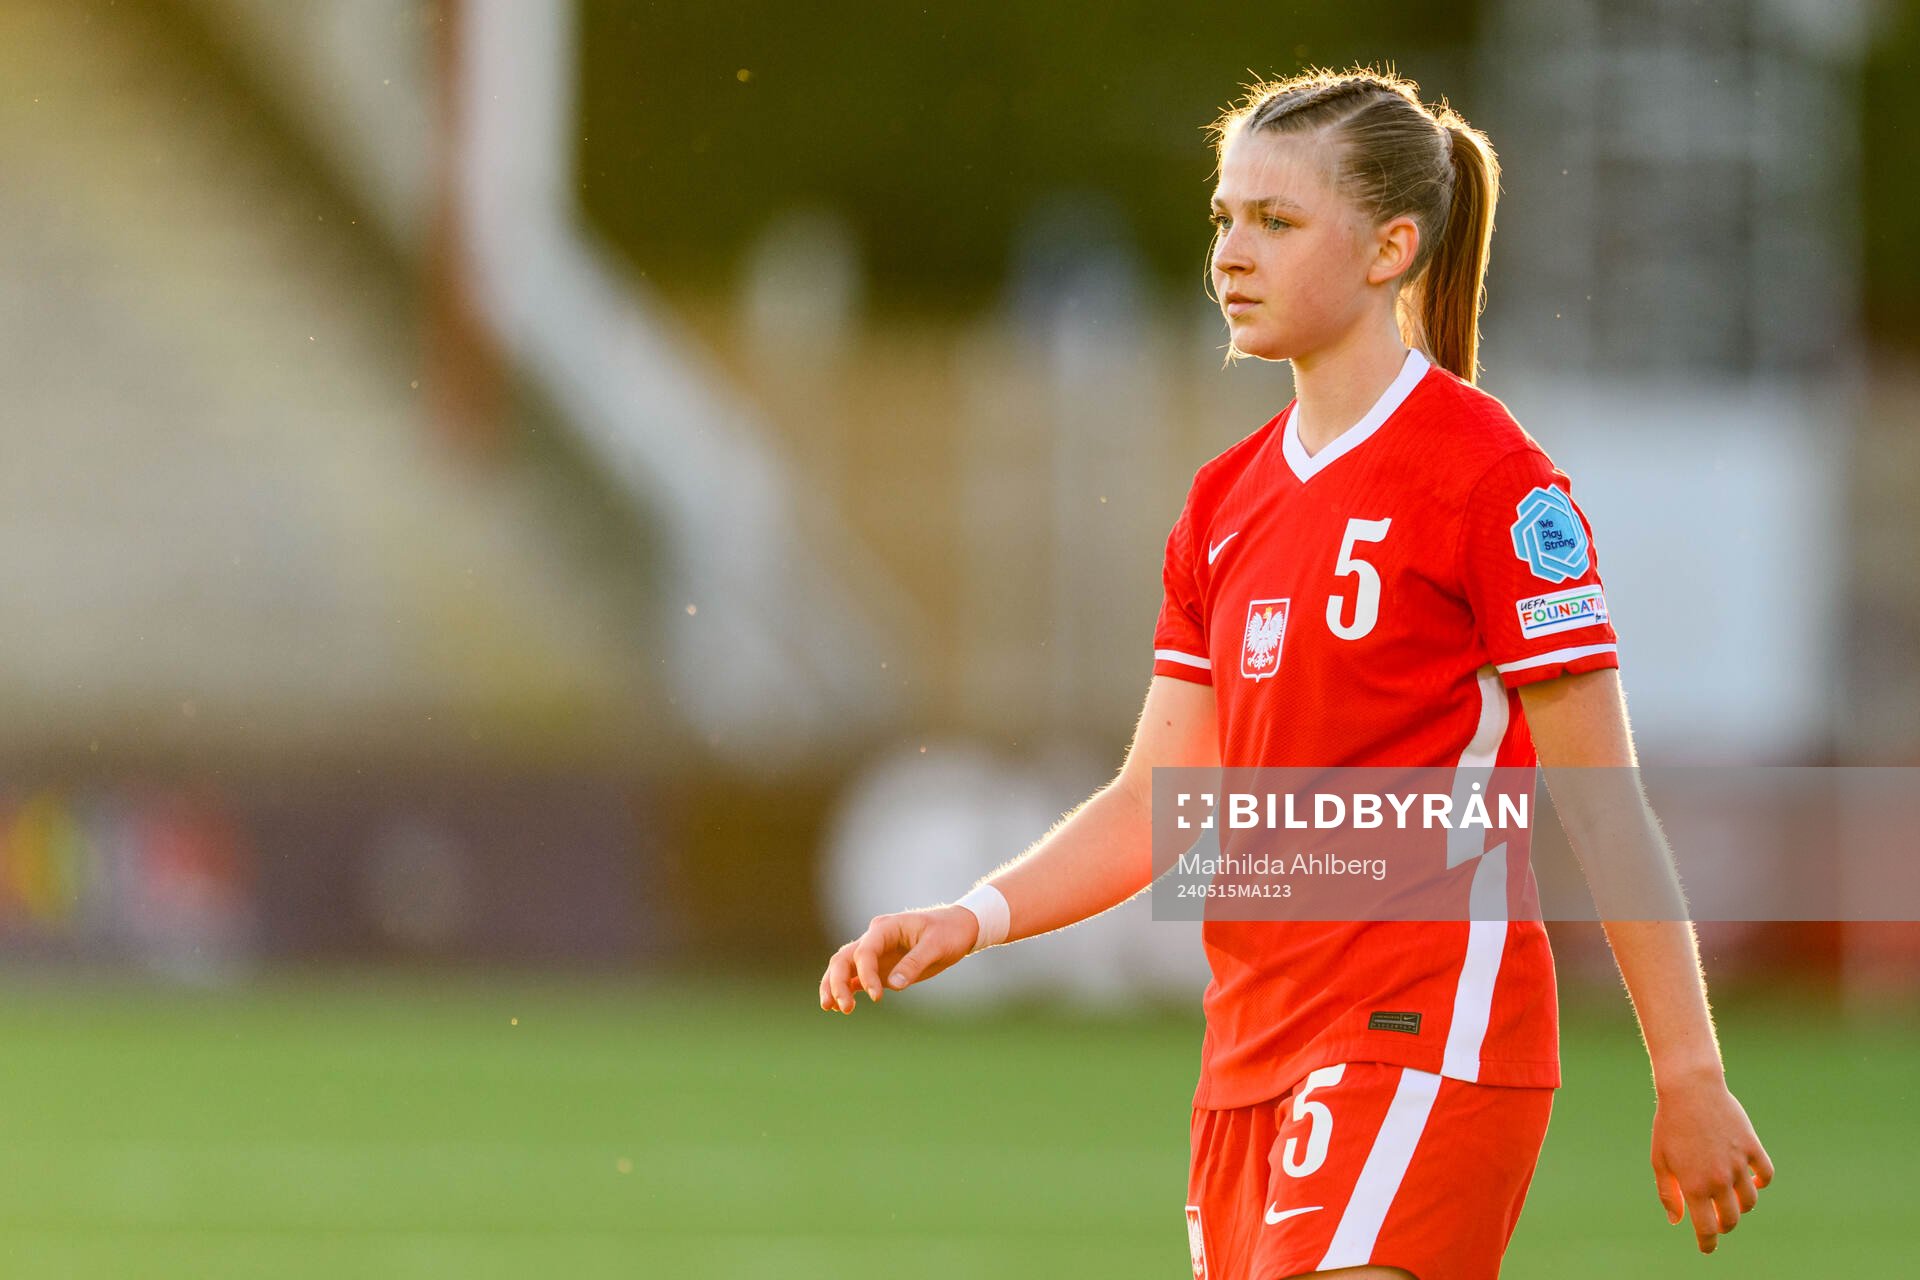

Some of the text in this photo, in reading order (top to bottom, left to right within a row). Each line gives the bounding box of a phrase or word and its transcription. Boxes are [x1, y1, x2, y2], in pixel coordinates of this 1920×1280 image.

[1539, 520, 1553, 528] We
[1542, 530, 1562, 540] Play
[1545, 538, 1575, 550] Strong
[1326, 517, 1392, 641] 5
[1521, 599, 1545, 611] UEFA
[1282, 1063, 1347, 1179] 5
